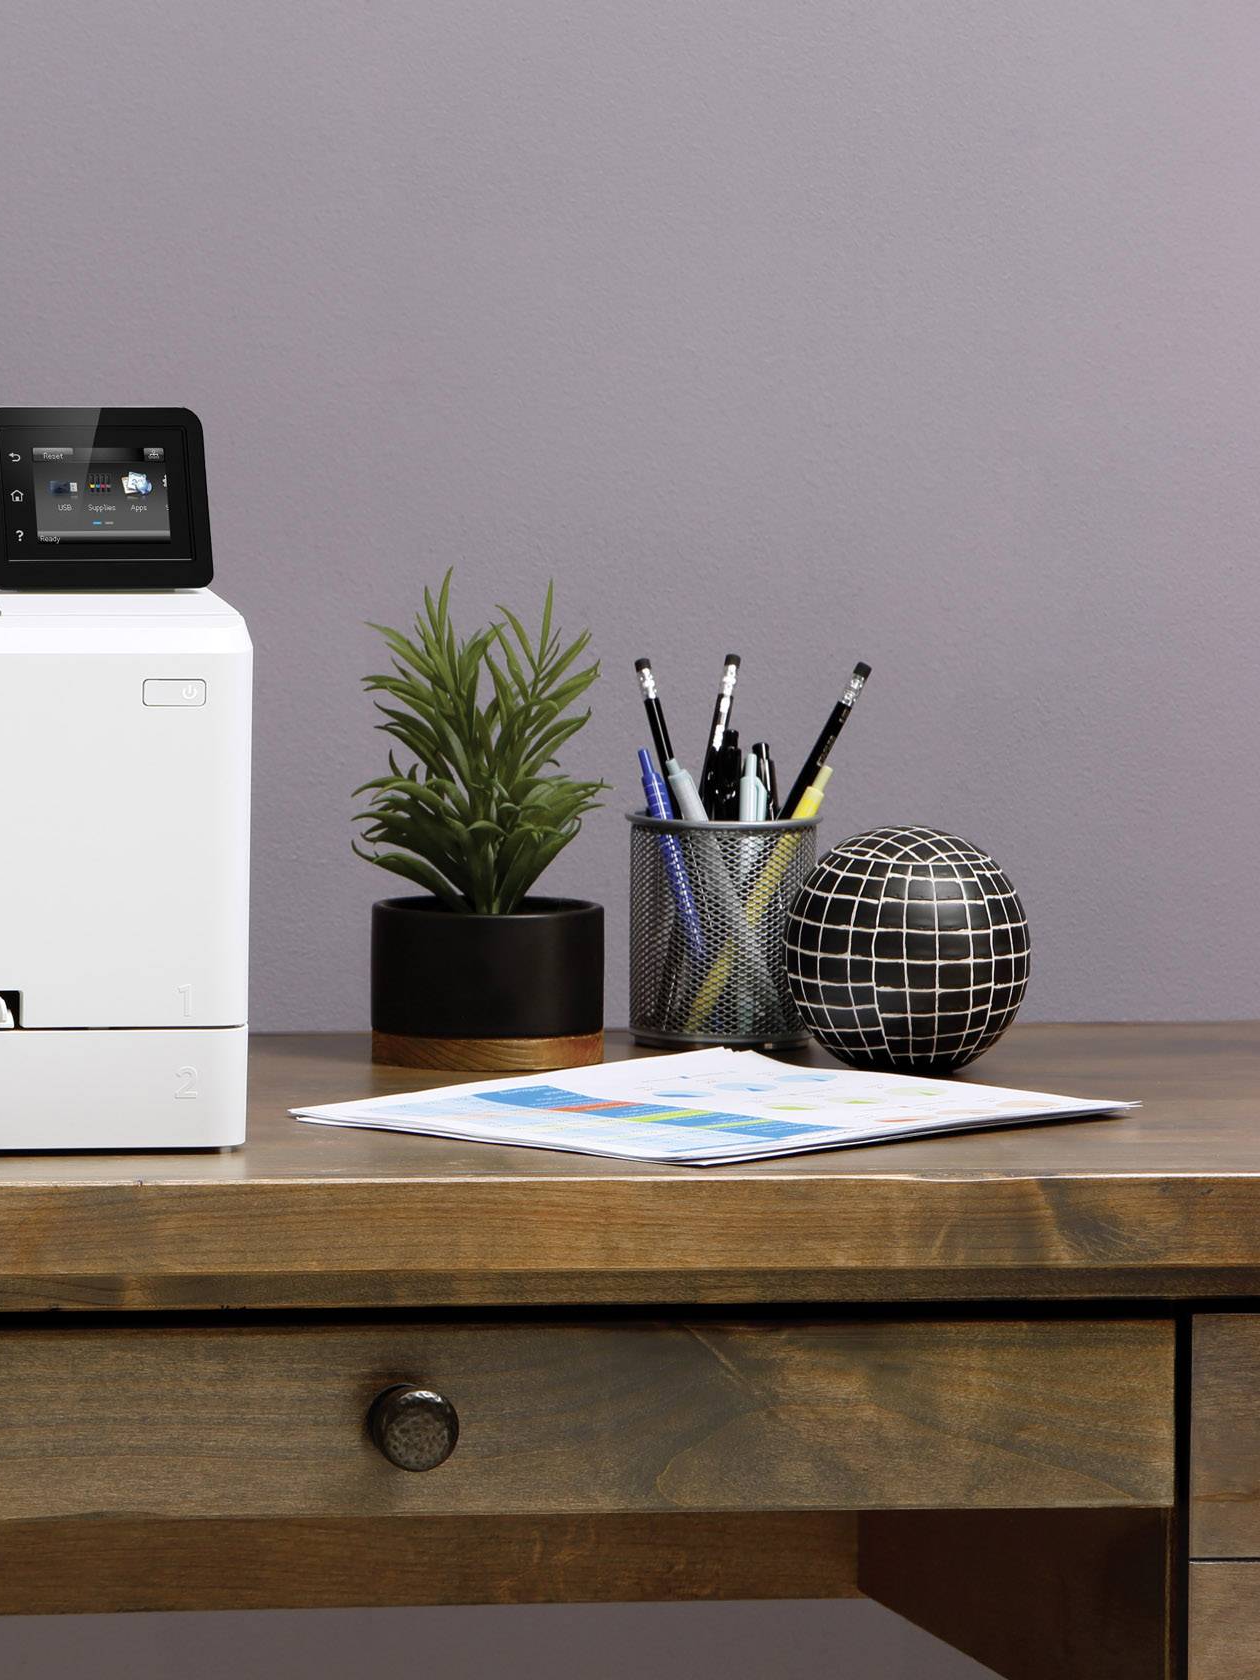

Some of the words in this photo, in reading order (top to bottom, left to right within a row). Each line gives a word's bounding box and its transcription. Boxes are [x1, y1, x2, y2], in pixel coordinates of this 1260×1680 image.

[42, 452, 64, 460] Reset
[57, 504, 73, 512] USB
[88, 503, 117, 513] Supplies
[130, 503, 148, 513] Apps
[39, 534, 61, 544] Ready
[177, 983, 193, 1017] 1
[174, 1065, 198, 1100] 2
